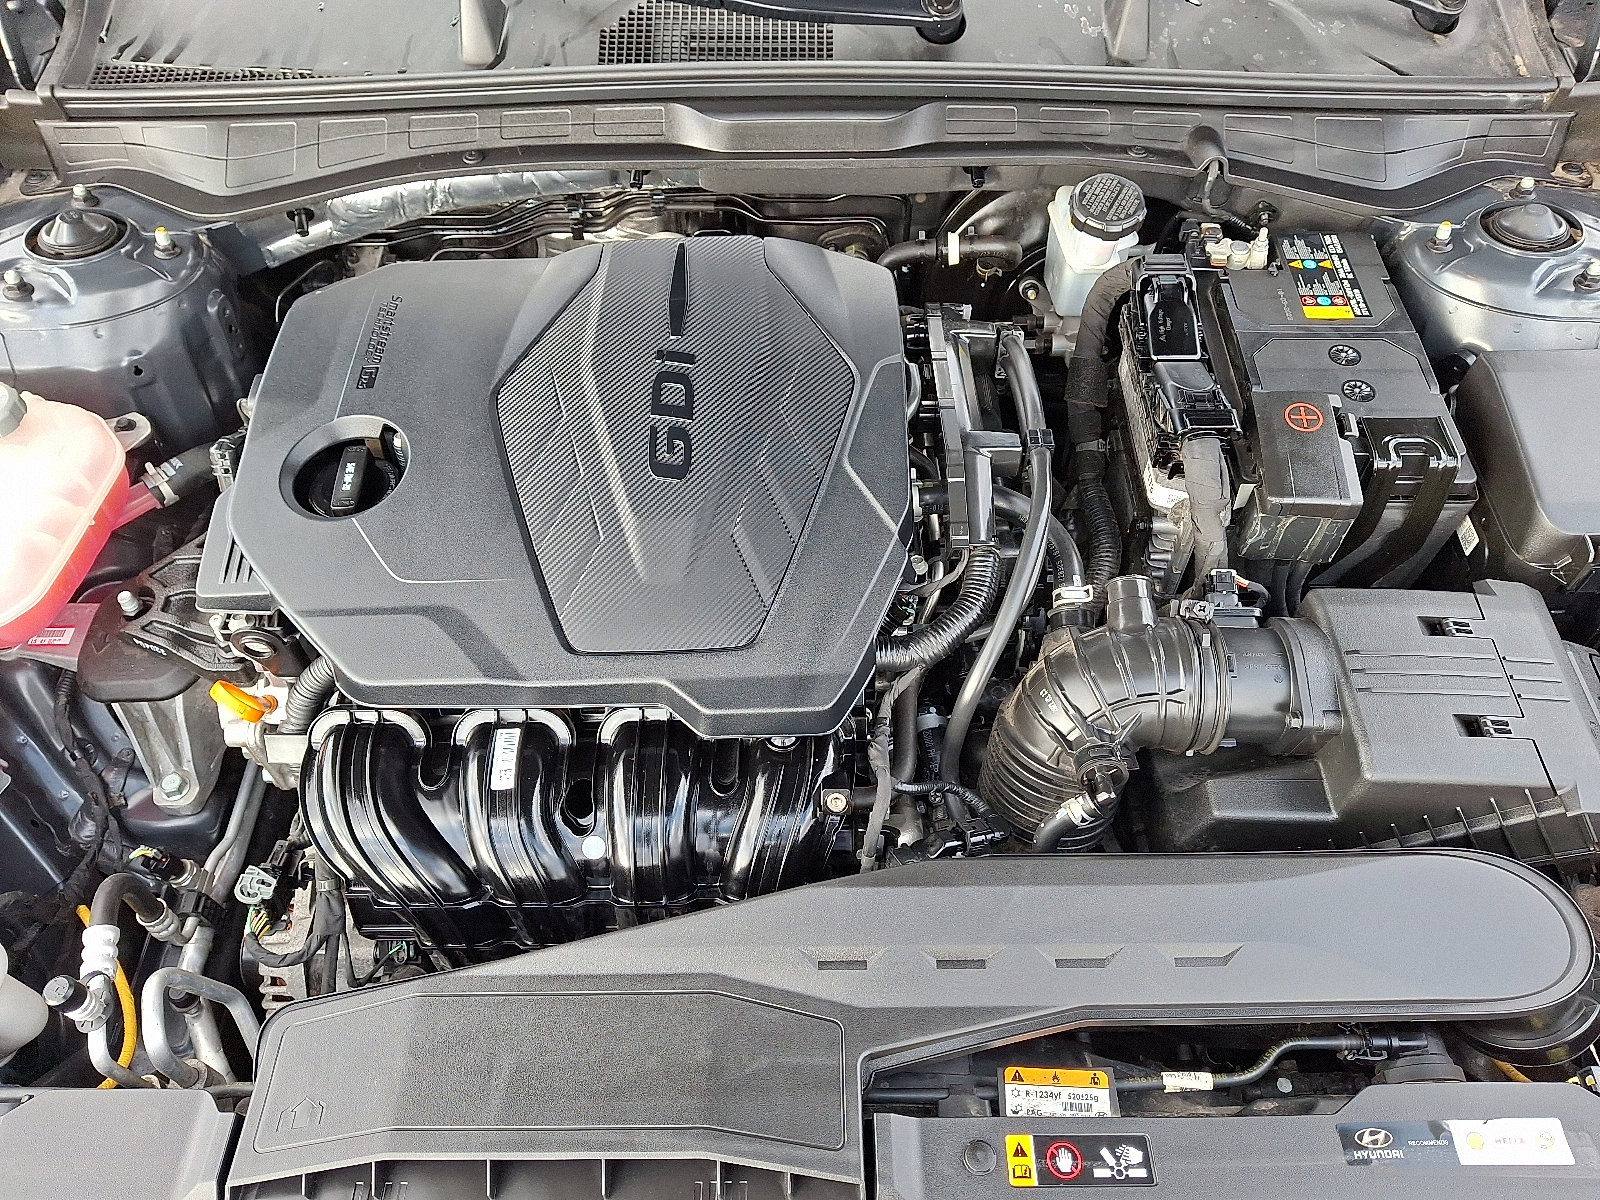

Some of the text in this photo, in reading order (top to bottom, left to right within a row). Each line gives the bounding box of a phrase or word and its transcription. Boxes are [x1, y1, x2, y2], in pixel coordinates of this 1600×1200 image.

[364, 302, 389, 363] TECHNOLOGY
[372, 294, 403, 365] Smartstream
[1025, 1090, 1062, 1101] R-1234yf
[1353, 1149, 1405, 1160] HYUNDAI
